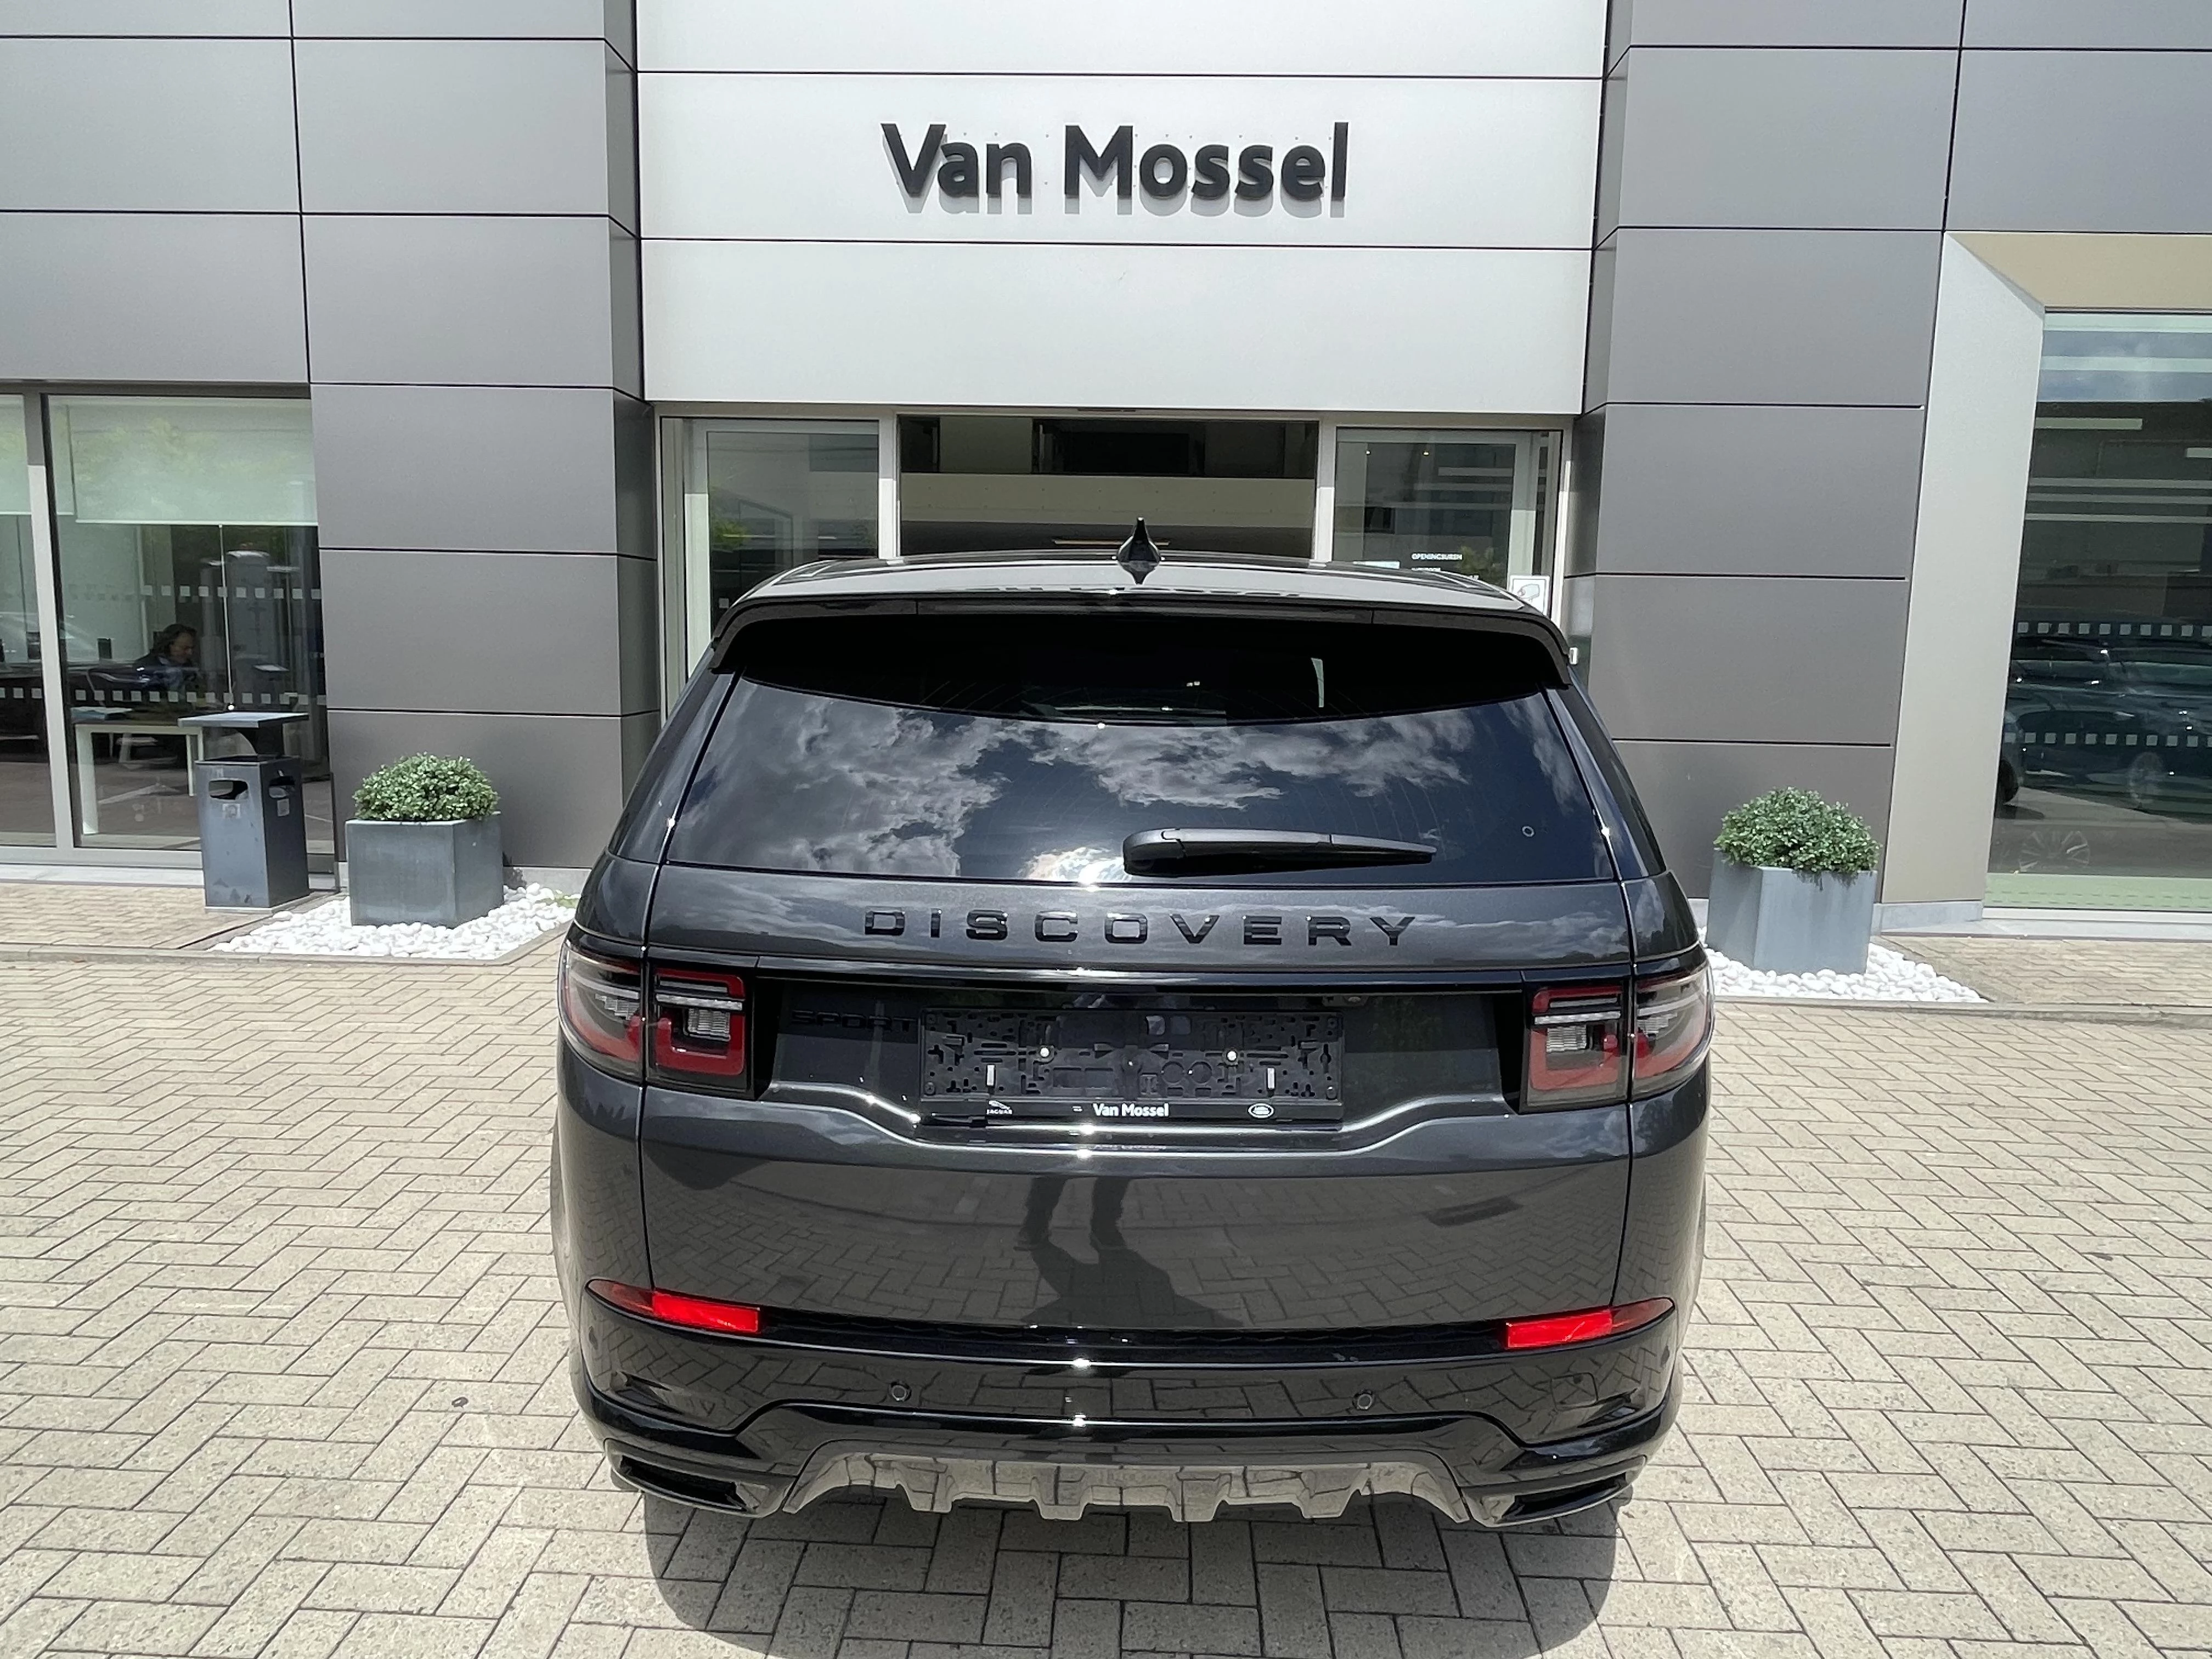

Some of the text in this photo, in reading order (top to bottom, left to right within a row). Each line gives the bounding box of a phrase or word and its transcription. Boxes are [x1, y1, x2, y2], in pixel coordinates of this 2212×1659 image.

[881, 122, 1348, 201] Van Mossel
[865, 907, 1415, 945] DISCOVERY
[792, 1009, 918, 1032] SPORT
[1093, 1103, 1169, 1116] Van Mossel
